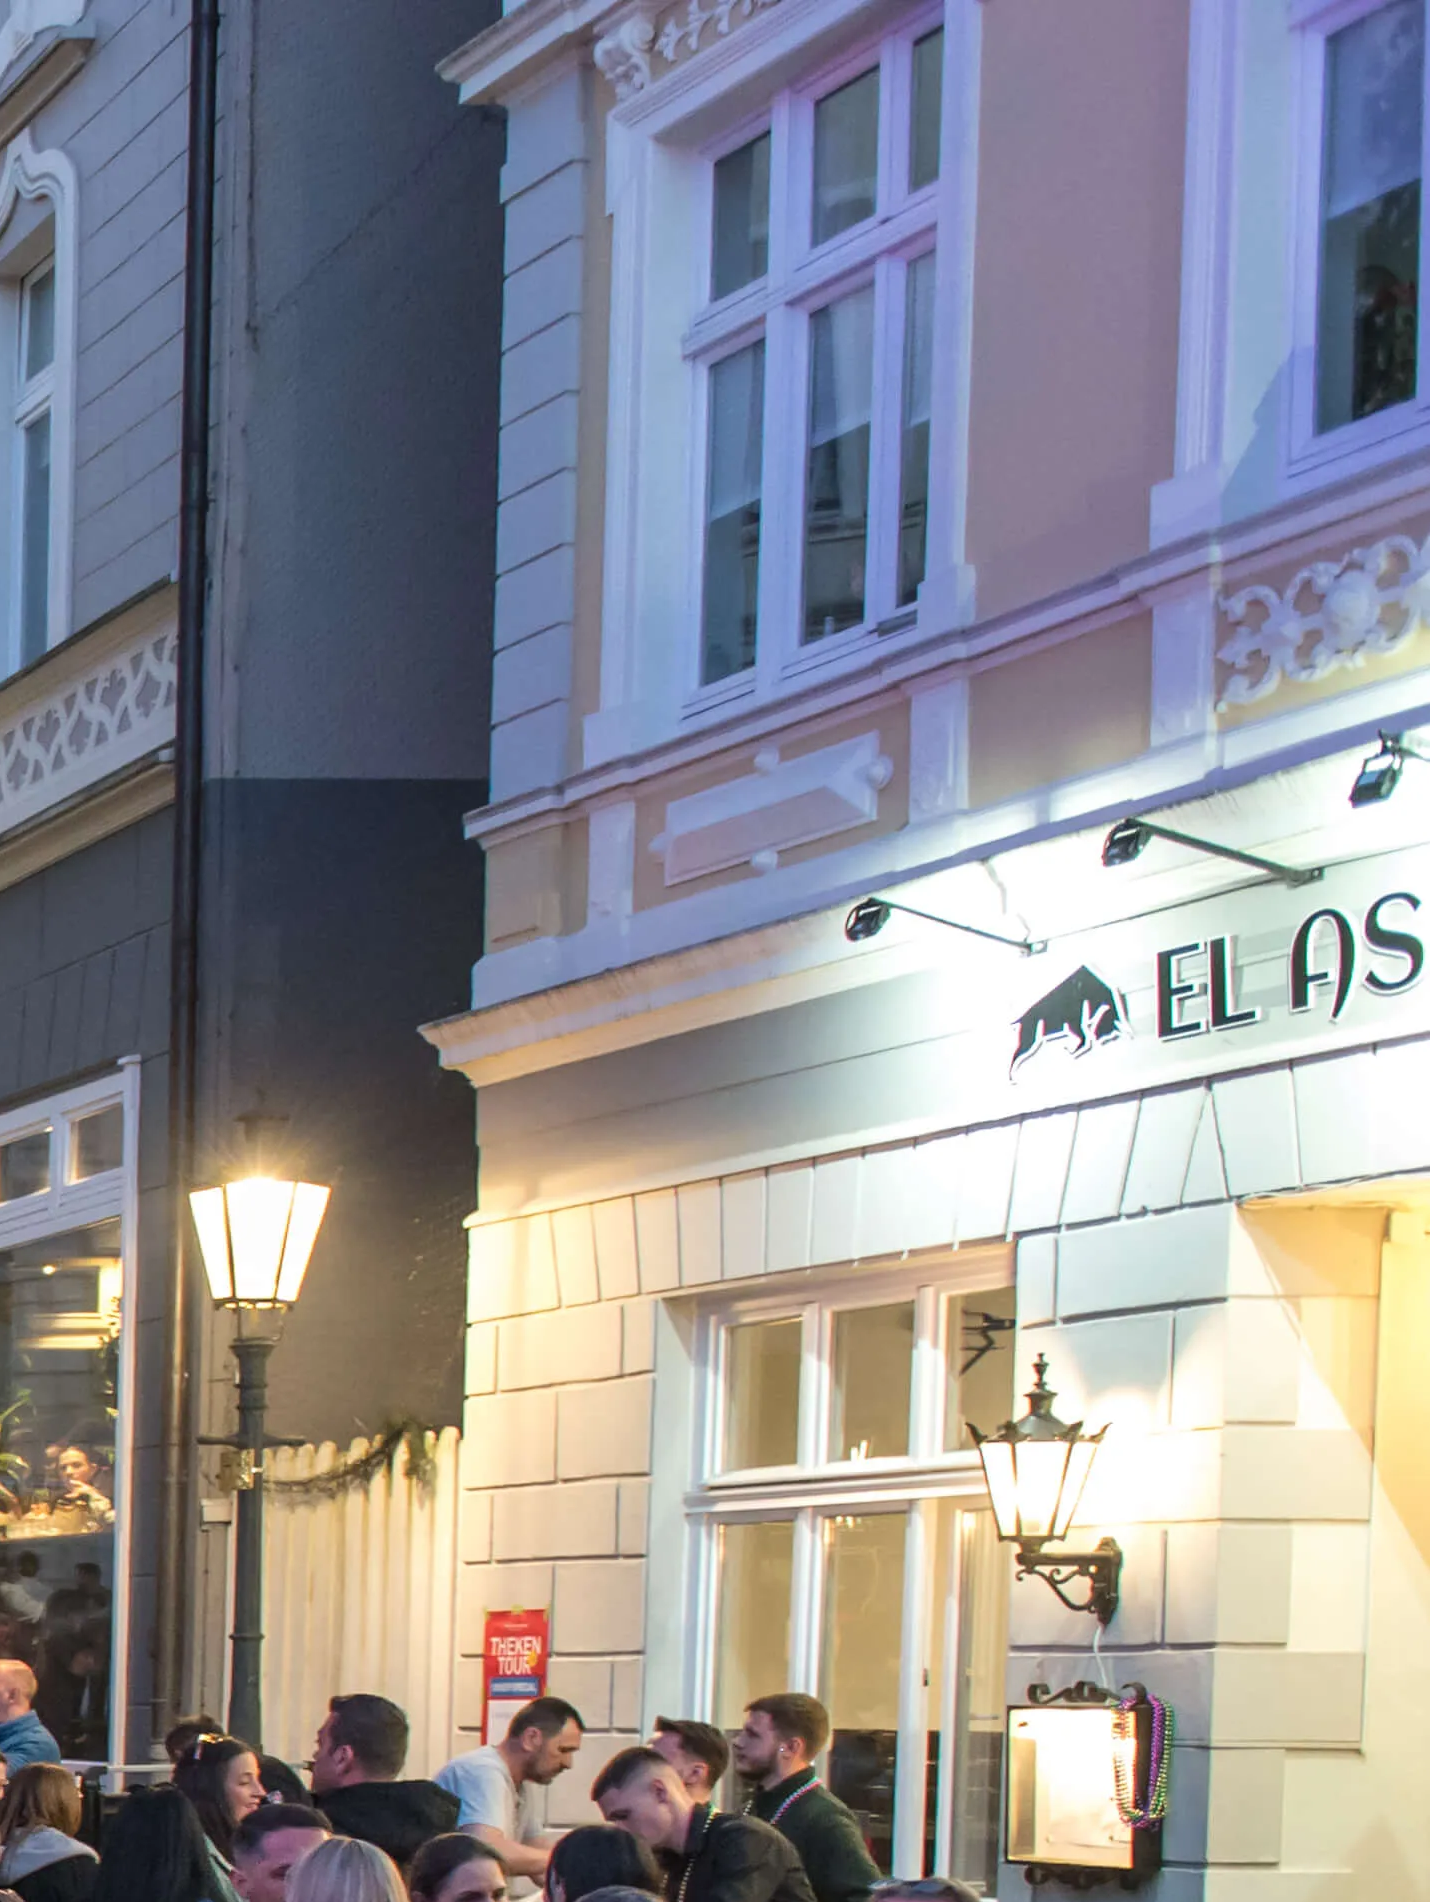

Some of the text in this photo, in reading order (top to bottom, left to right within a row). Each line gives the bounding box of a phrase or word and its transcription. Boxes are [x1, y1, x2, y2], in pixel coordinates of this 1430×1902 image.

[1156, 892, 1424, 1040] EL AS
[490, 1635, 542, 1657] THEKEN
[496, 1655, 532, 1676] TOUR
